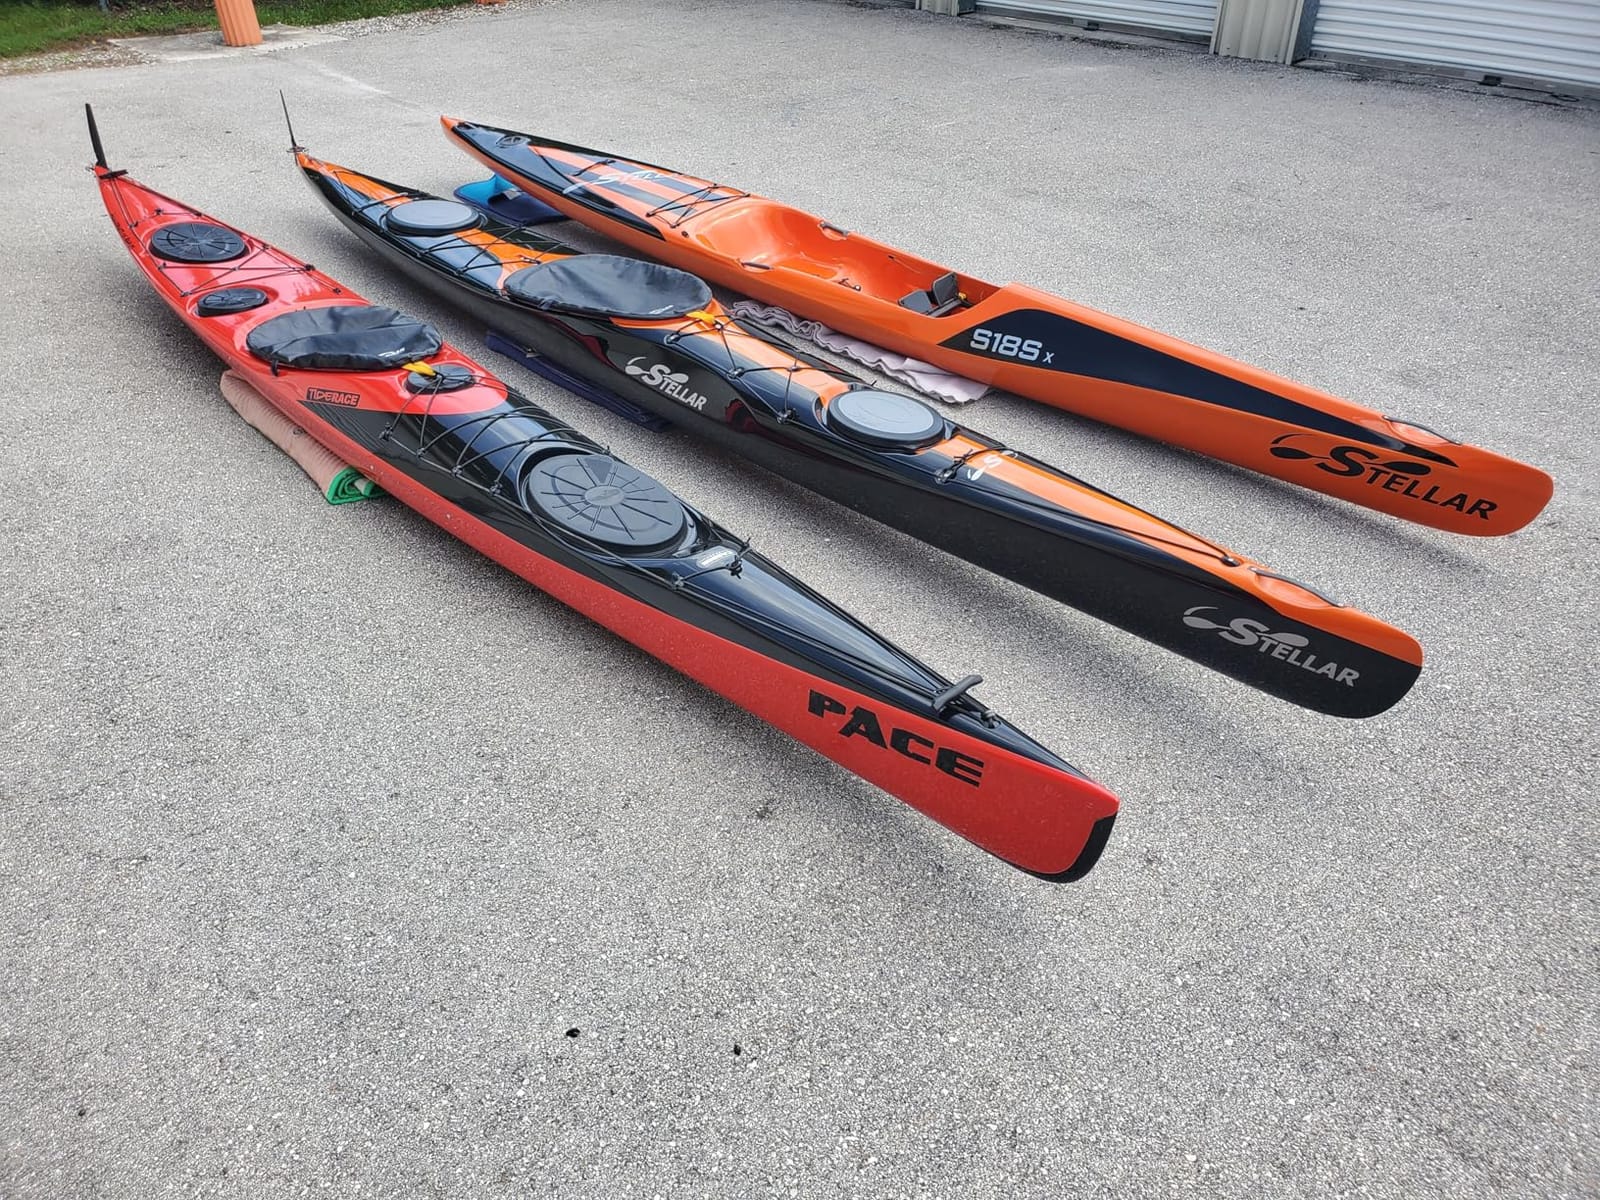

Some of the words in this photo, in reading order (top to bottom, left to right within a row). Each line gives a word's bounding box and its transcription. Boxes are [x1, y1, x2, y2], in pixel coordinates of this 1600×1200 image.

[970, 328, 1043, 361] S18S
[308, 388, 359, 405] TIDERACE
[641, 364, 707, 410] STELLAR
[1314, 445, 1498, 520] STELLAR
[1218, 618, 1360, 687] STELLAR
[808, 689, 985, 788] PACE
